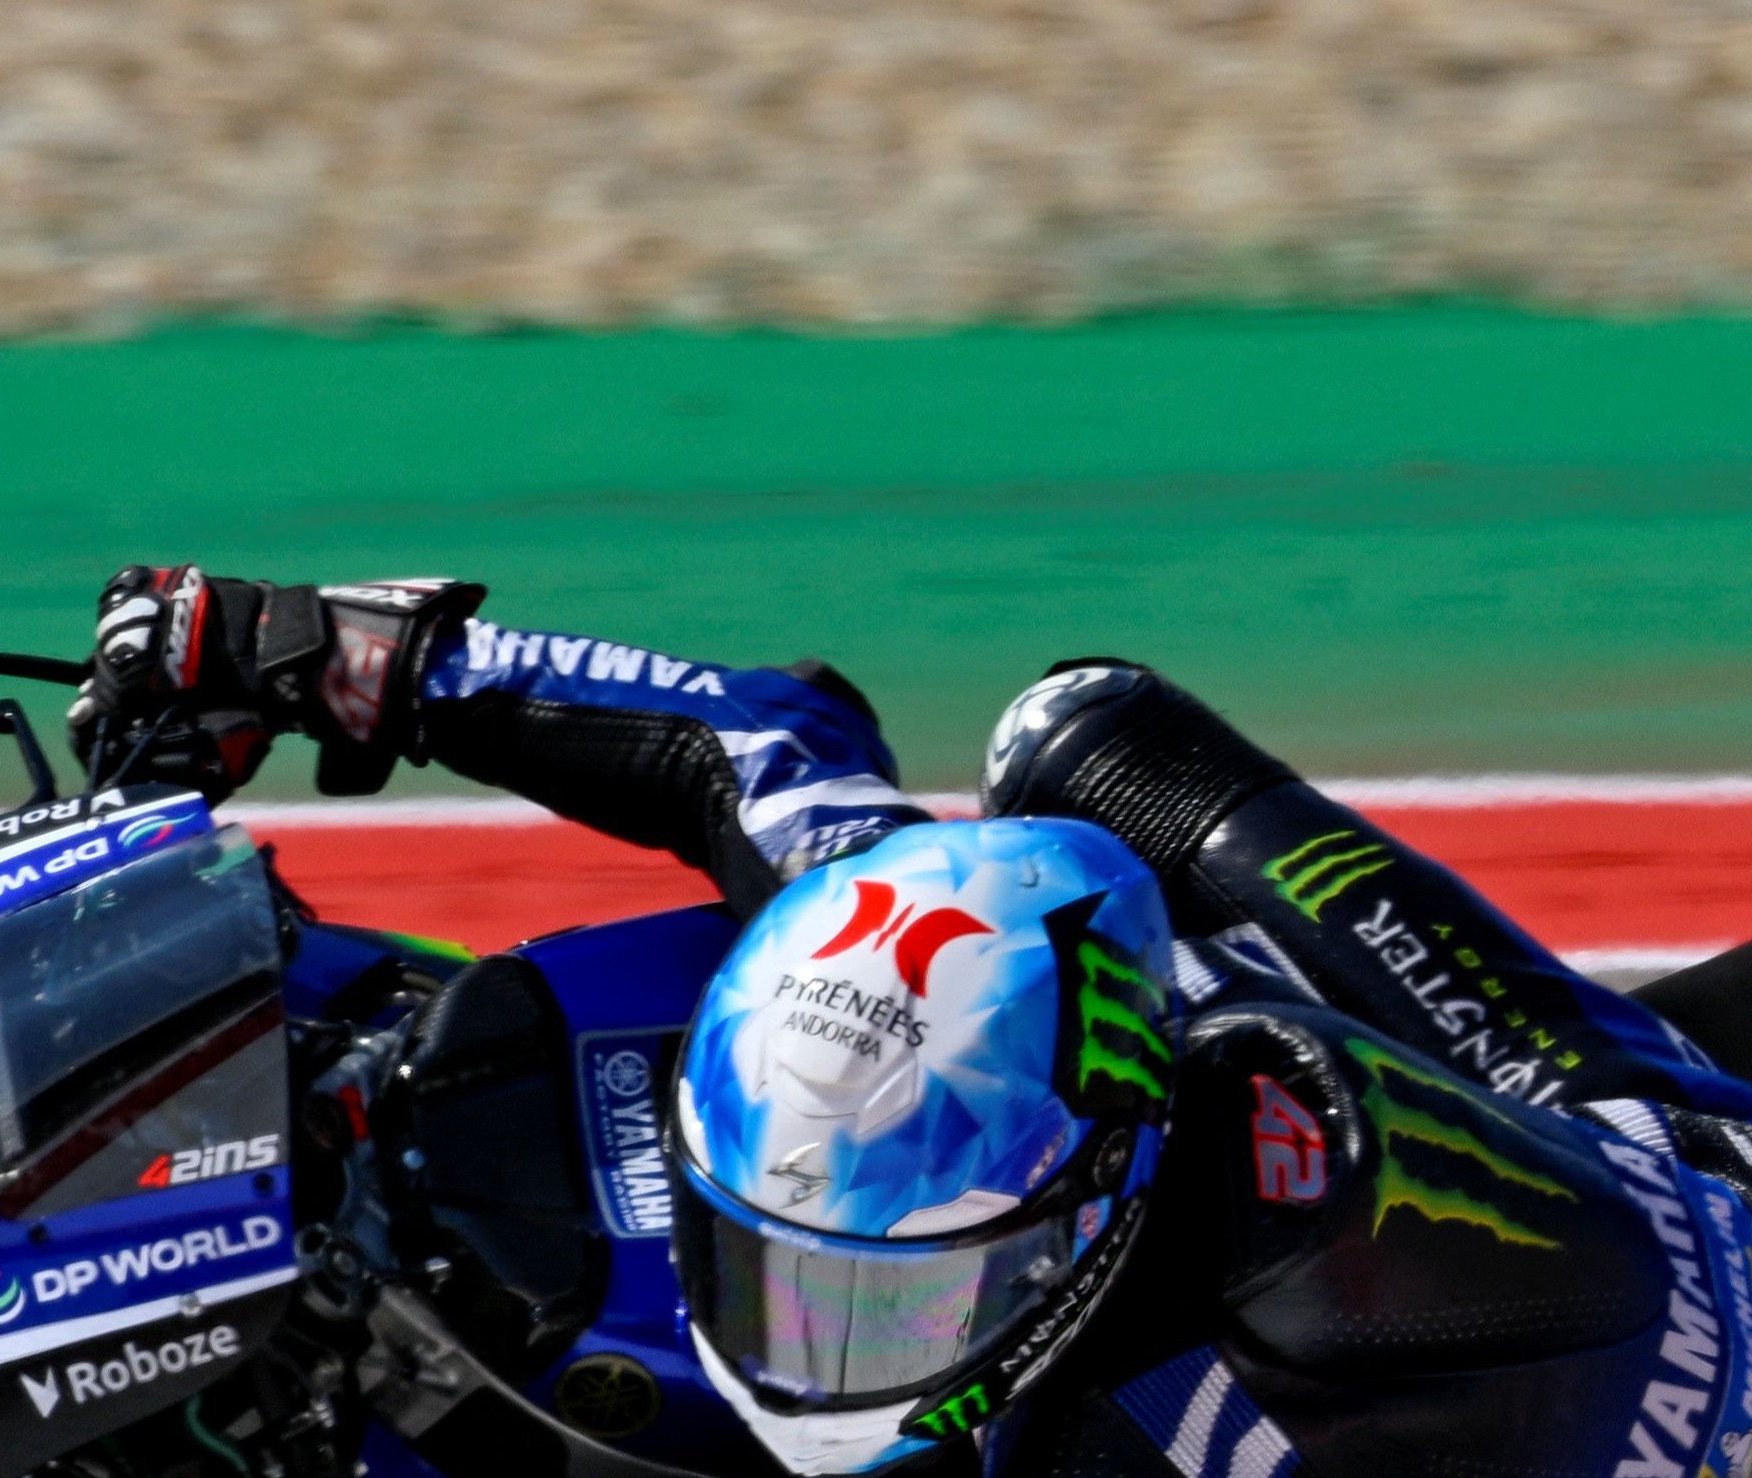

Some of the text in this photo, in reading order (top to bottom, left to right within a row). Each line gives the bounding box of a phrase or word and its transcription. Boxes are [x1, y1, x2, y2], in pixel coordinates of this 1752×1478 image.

[464, 617, 726, 697] YAMAHA
[44, 837, 110, 878] DP
[784, 1010, 883, 1063] ANDORRA
[610, 1098, 674, 1231] YAMAHA
[1248, 1072, 1327, 1204] 42
[32, 1214, 281, 1303] DP WORLD
[65, 1322, 241, 1404] Roboze
